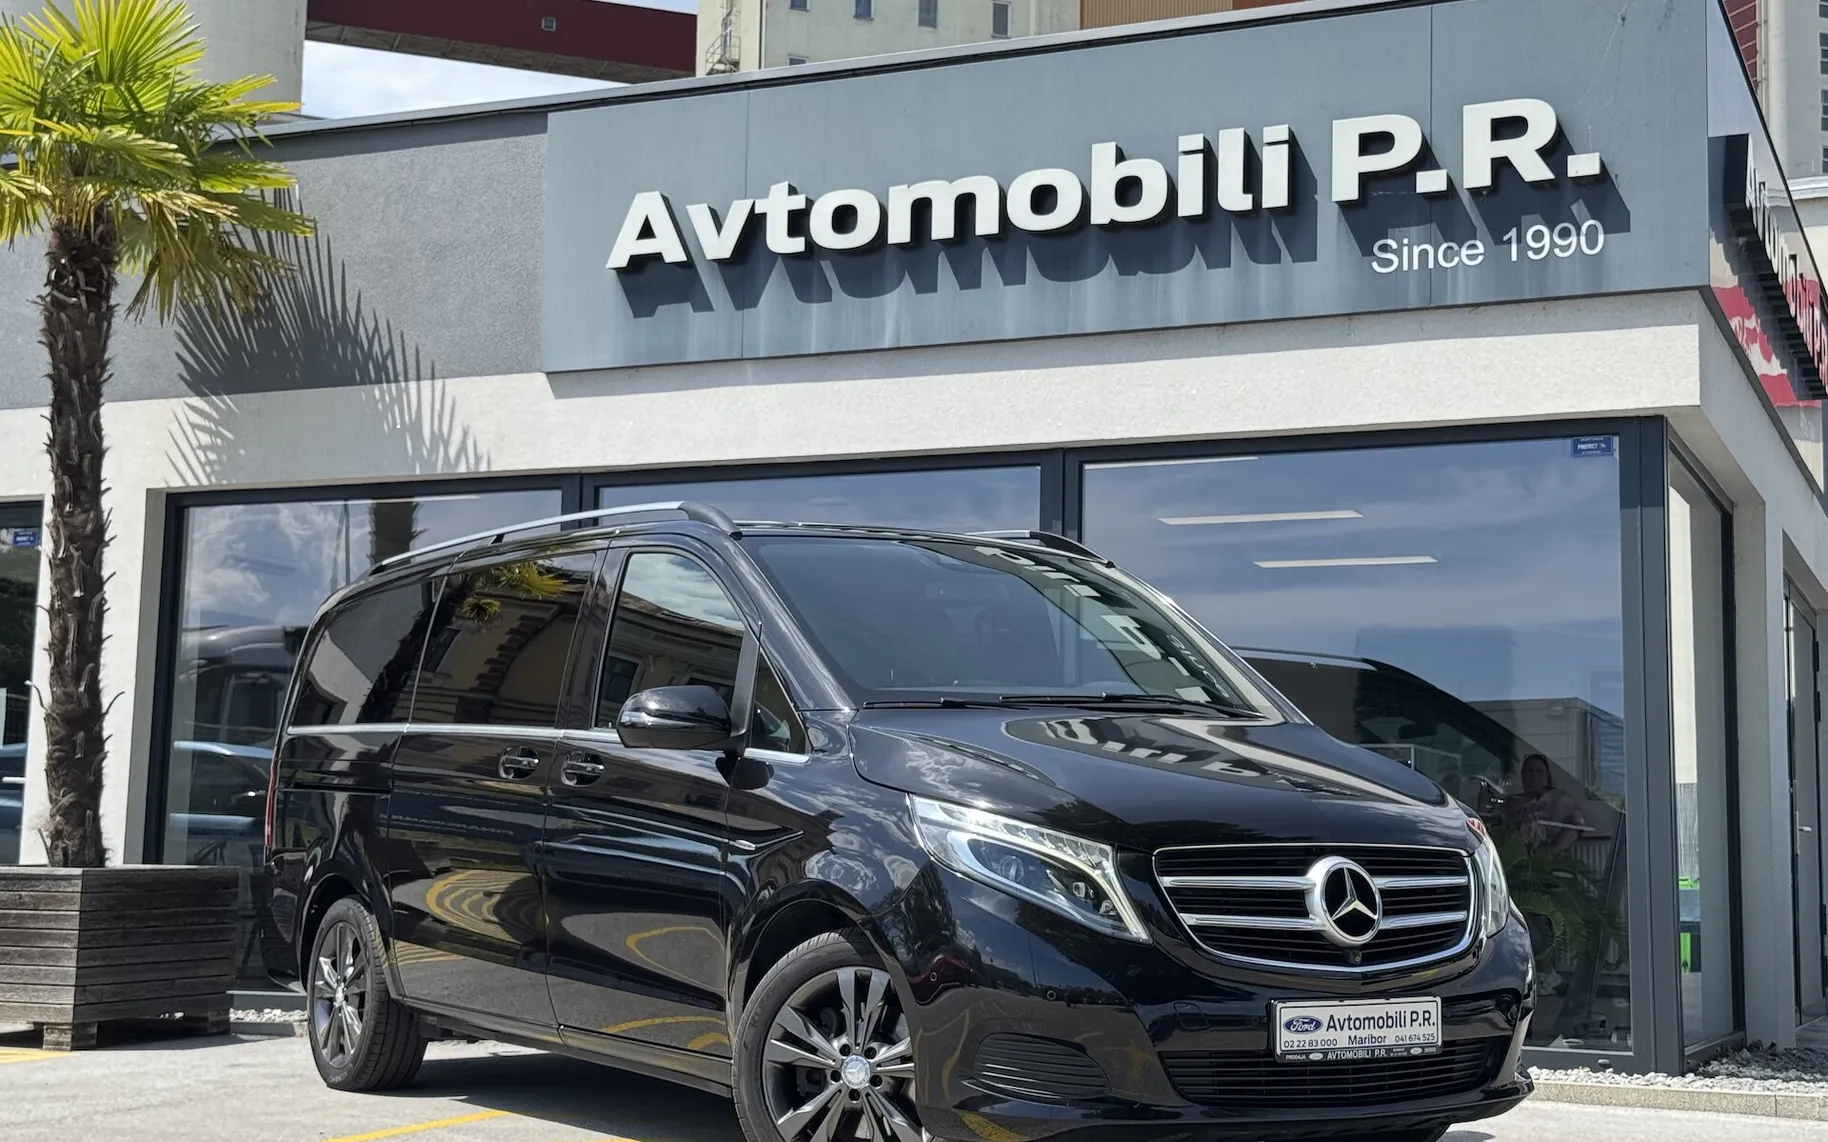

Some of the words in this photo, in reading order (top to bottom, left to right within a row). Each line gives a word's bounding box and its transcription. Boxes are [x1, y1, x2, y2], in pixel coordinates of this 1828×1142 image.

[606, 124, 1289, 269] Avtomobili
[1332, 98, 1600, 201] P.R.
[1371, 238, 1485, 274] Since
[1502, 218, 1605, 262] 1990
[1290, 1018, 1317, 1031] Ford
[1326, 1010, 1407, 1032] Avtomobili
[1410, 1009, 1436, 1027] P.R.
[1283, 1040, 1295, 1048] 02
[1296, 1040, 1307, 1048] 22
[1307, 1039, 1319, 1047] 83
[1320, 1038, 1338, 1047] 000
[1347, 1034, 1387, 1046] Maribor
[1394, 1034, 1407, 1043] 041
[1408, 1033, 1420, 1042] 674
[1422, 1033, 1435, 1042] 525
[1326, 1049, 1372, 1060] AVTOMOBILI
[1374, 1048, 1388, 1058] P.R.
